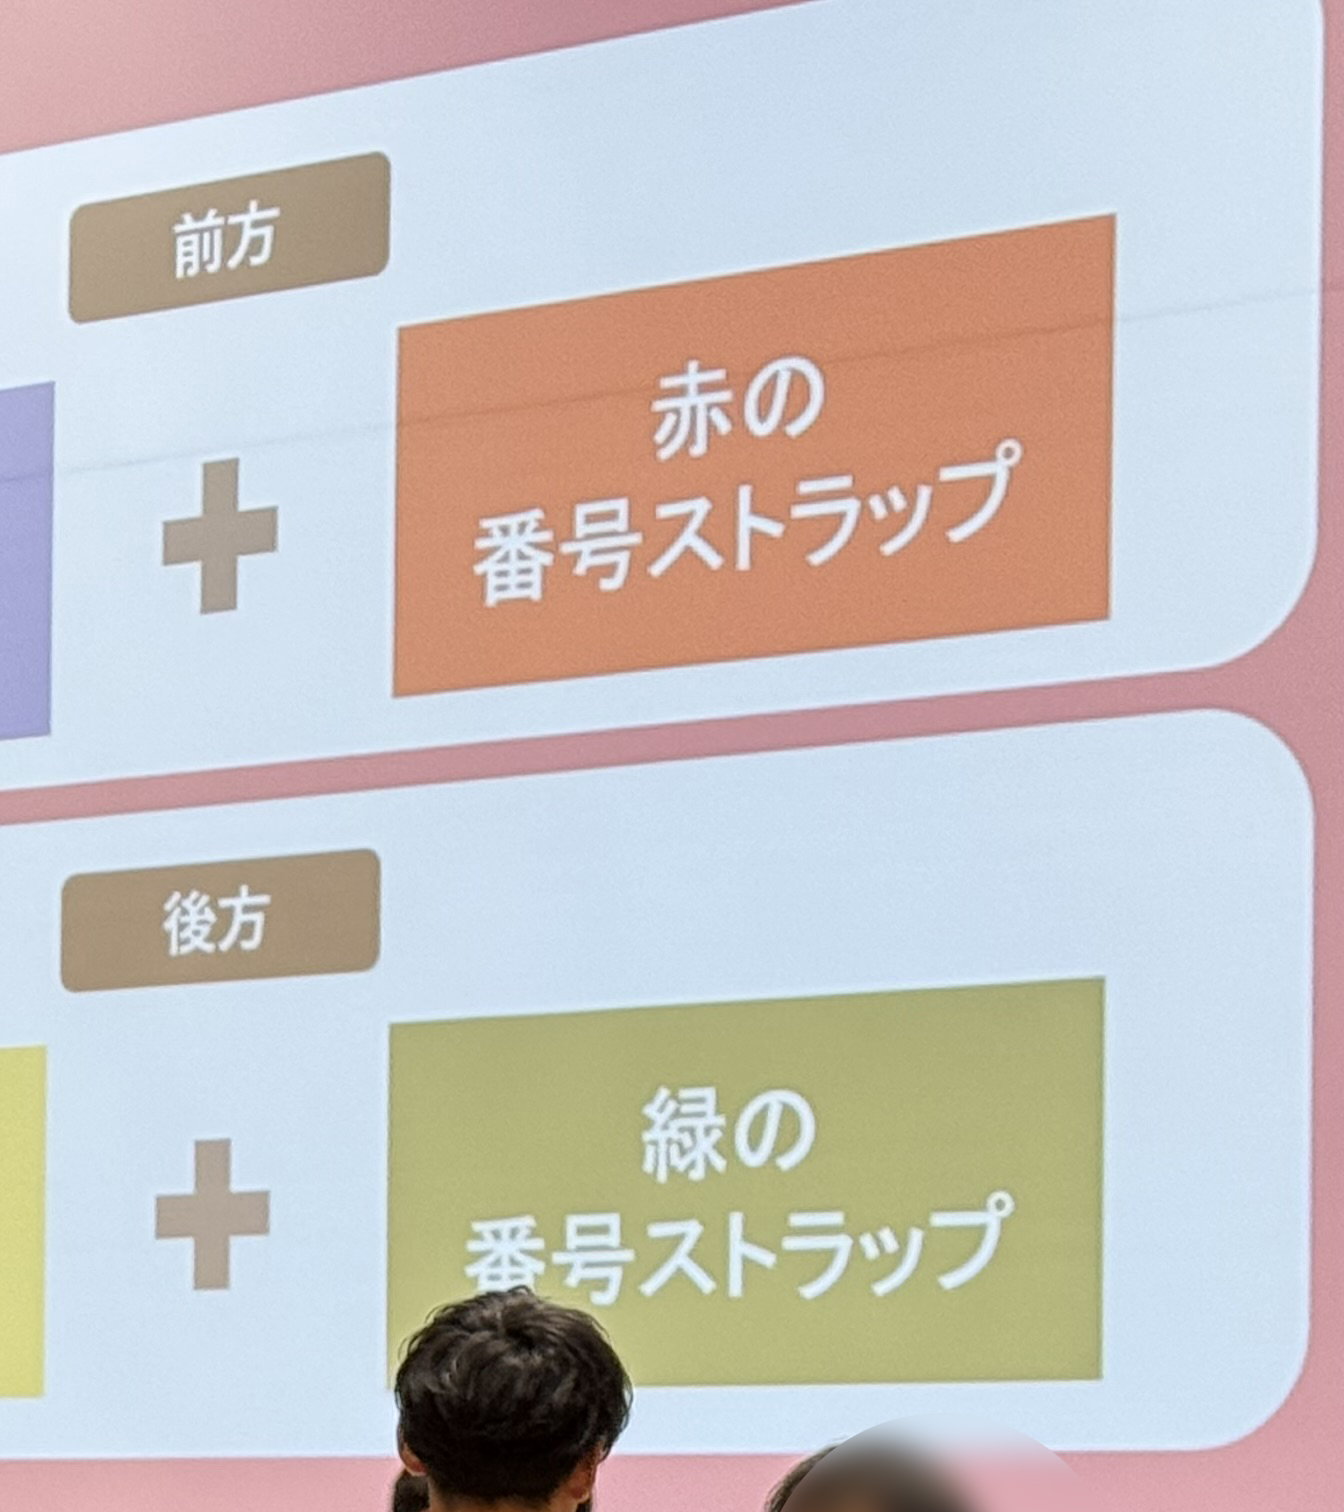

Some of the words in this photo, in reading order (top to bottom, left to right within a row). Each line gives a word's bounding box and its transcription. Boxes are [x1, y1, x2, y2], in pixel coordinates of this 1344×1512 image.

[172, 201, 281, 279] 前方
[651, 356, 825, 461] 赤の
[473, 438, 1023, 609] 番号ストラップ
[162, 885, 272, 956] 後方
[640, 1086, 816, 1184] 緑の
[464, 1191, 1016, 1306] 番号ストラップ
